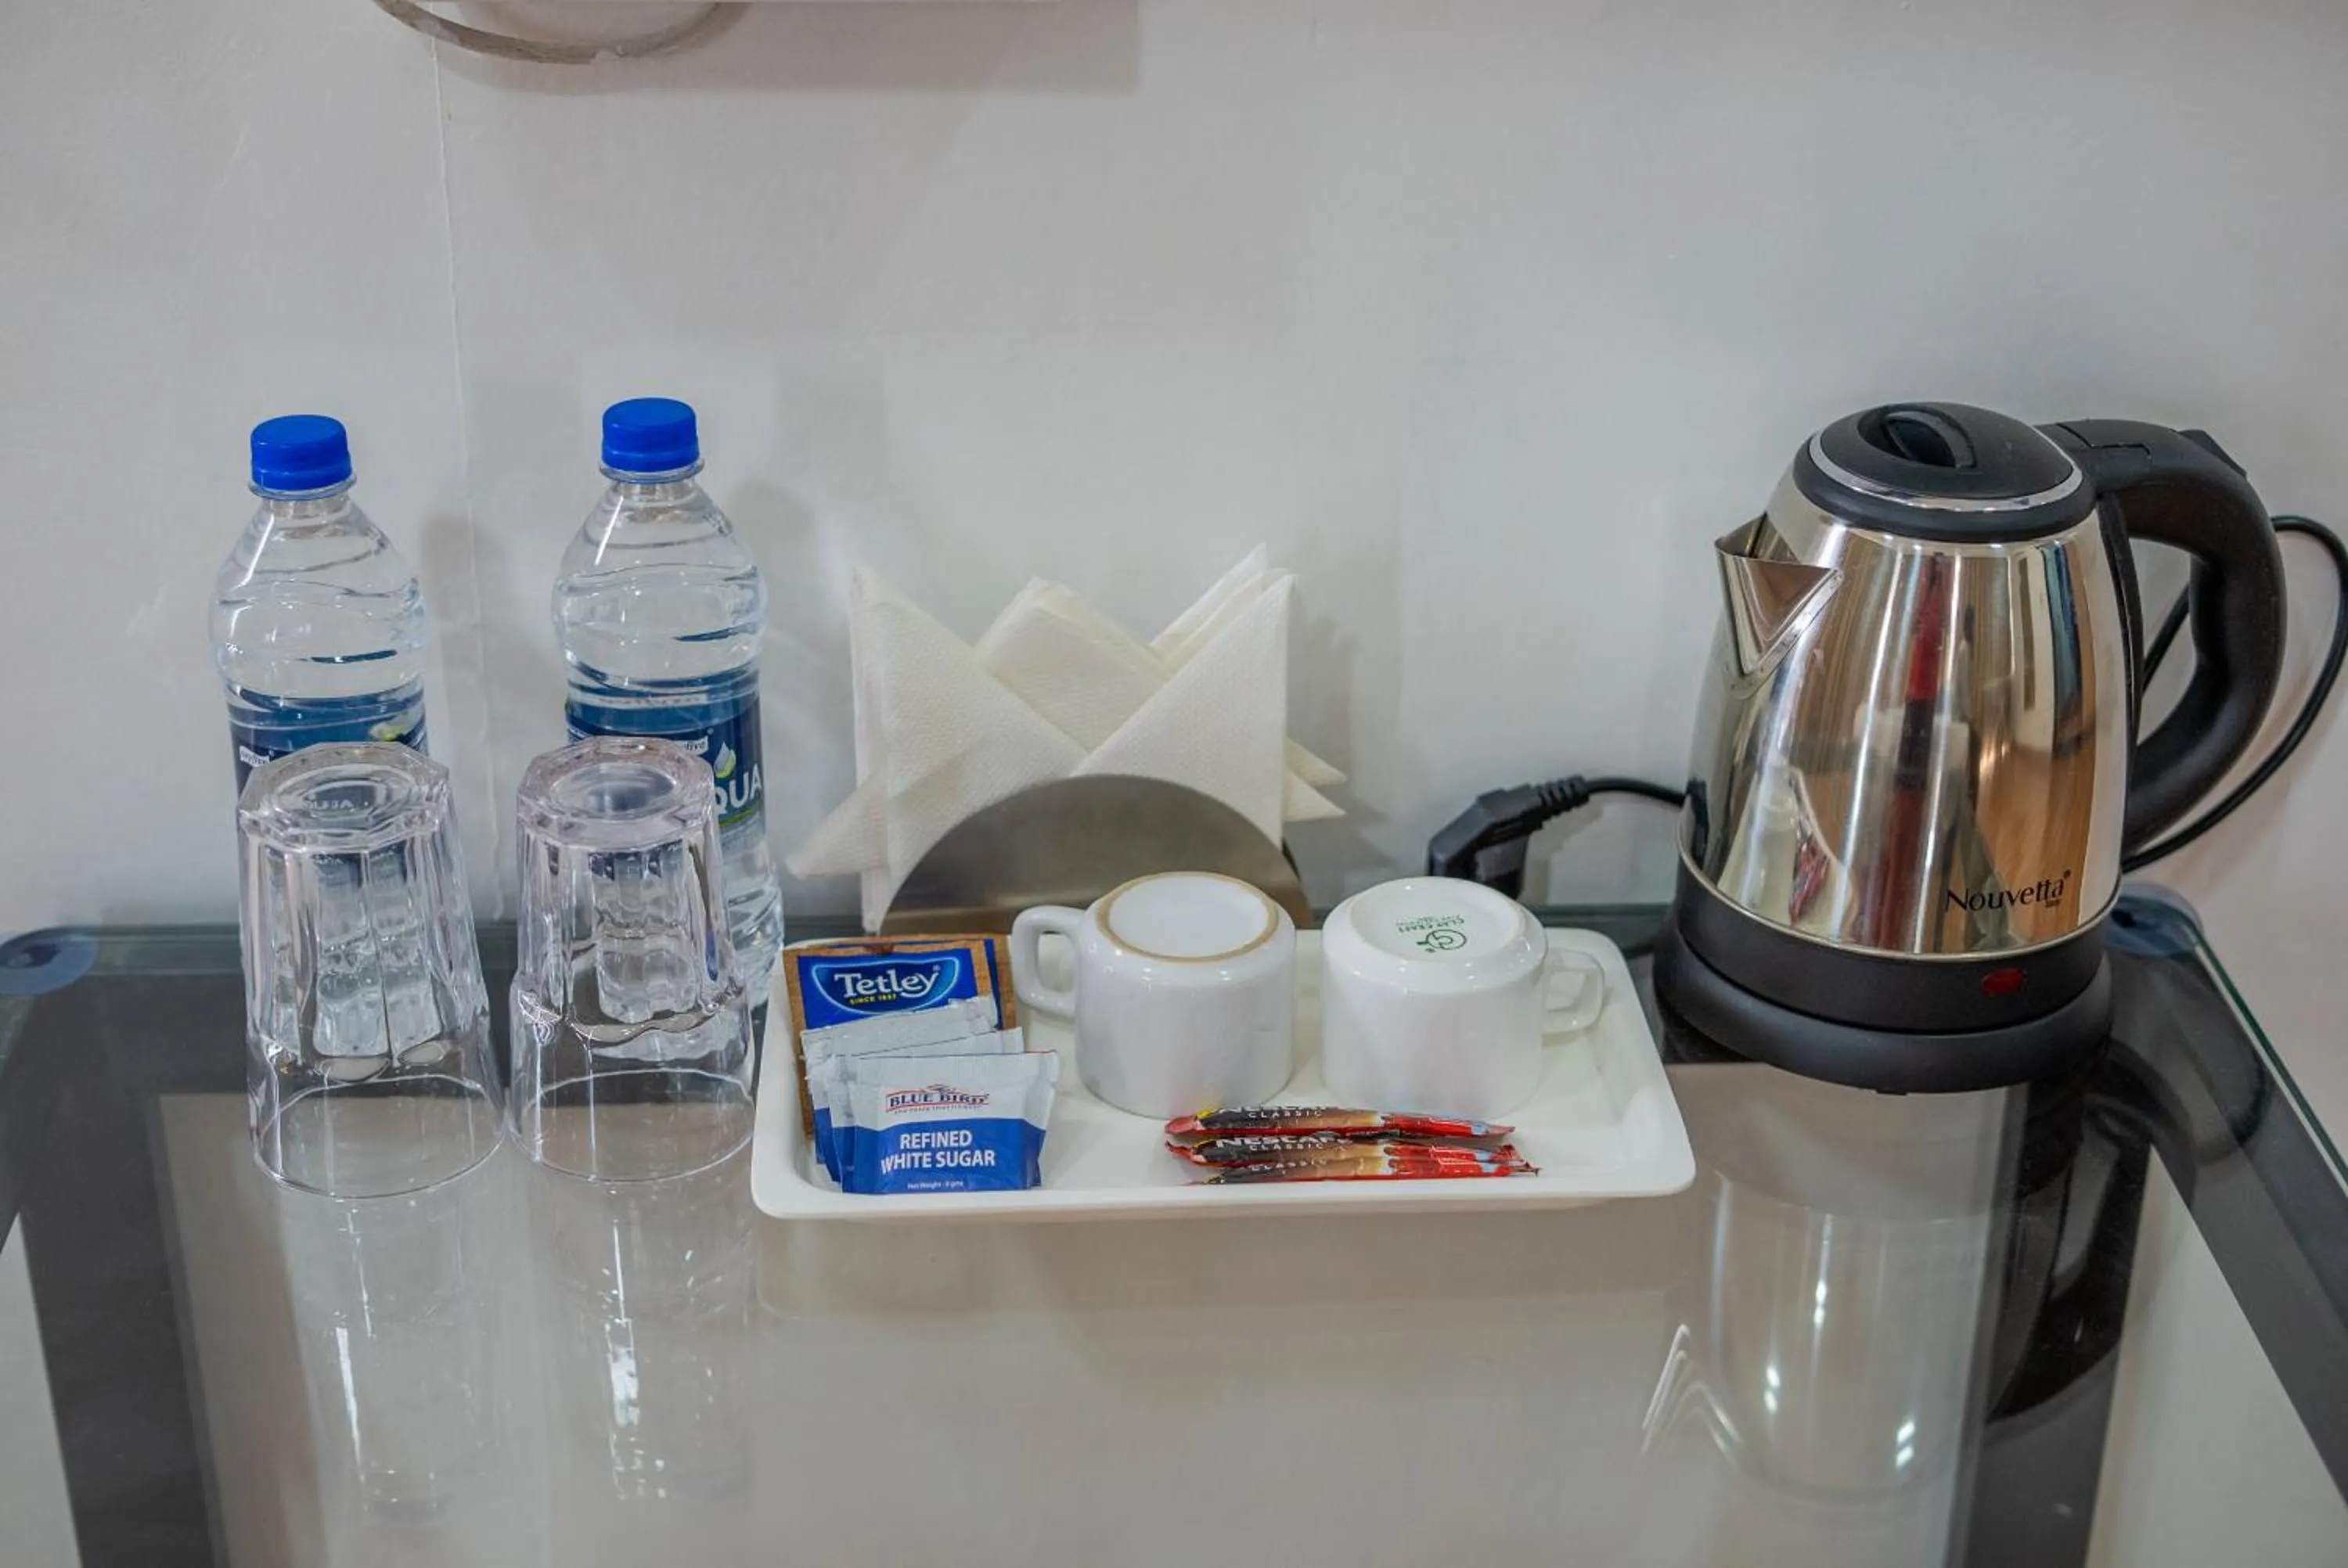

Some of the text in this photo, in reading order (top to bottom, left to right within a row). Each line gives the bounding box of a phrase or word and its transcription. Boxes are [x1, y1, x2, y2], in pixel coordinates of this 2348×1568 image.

[713, 762, 762, 815] QUA
[1945, 878, 2065, 912] Nouvetta
[834, 968, 939, 998] Tetley
[889, 1094, 933, 1107] BLUE
[1248, 1109, 1323, 1119] CLASSIC
[900, 1129, 973, 1149] REFINED
[880, 1149, 996, 1174] WHITE SUGAR
